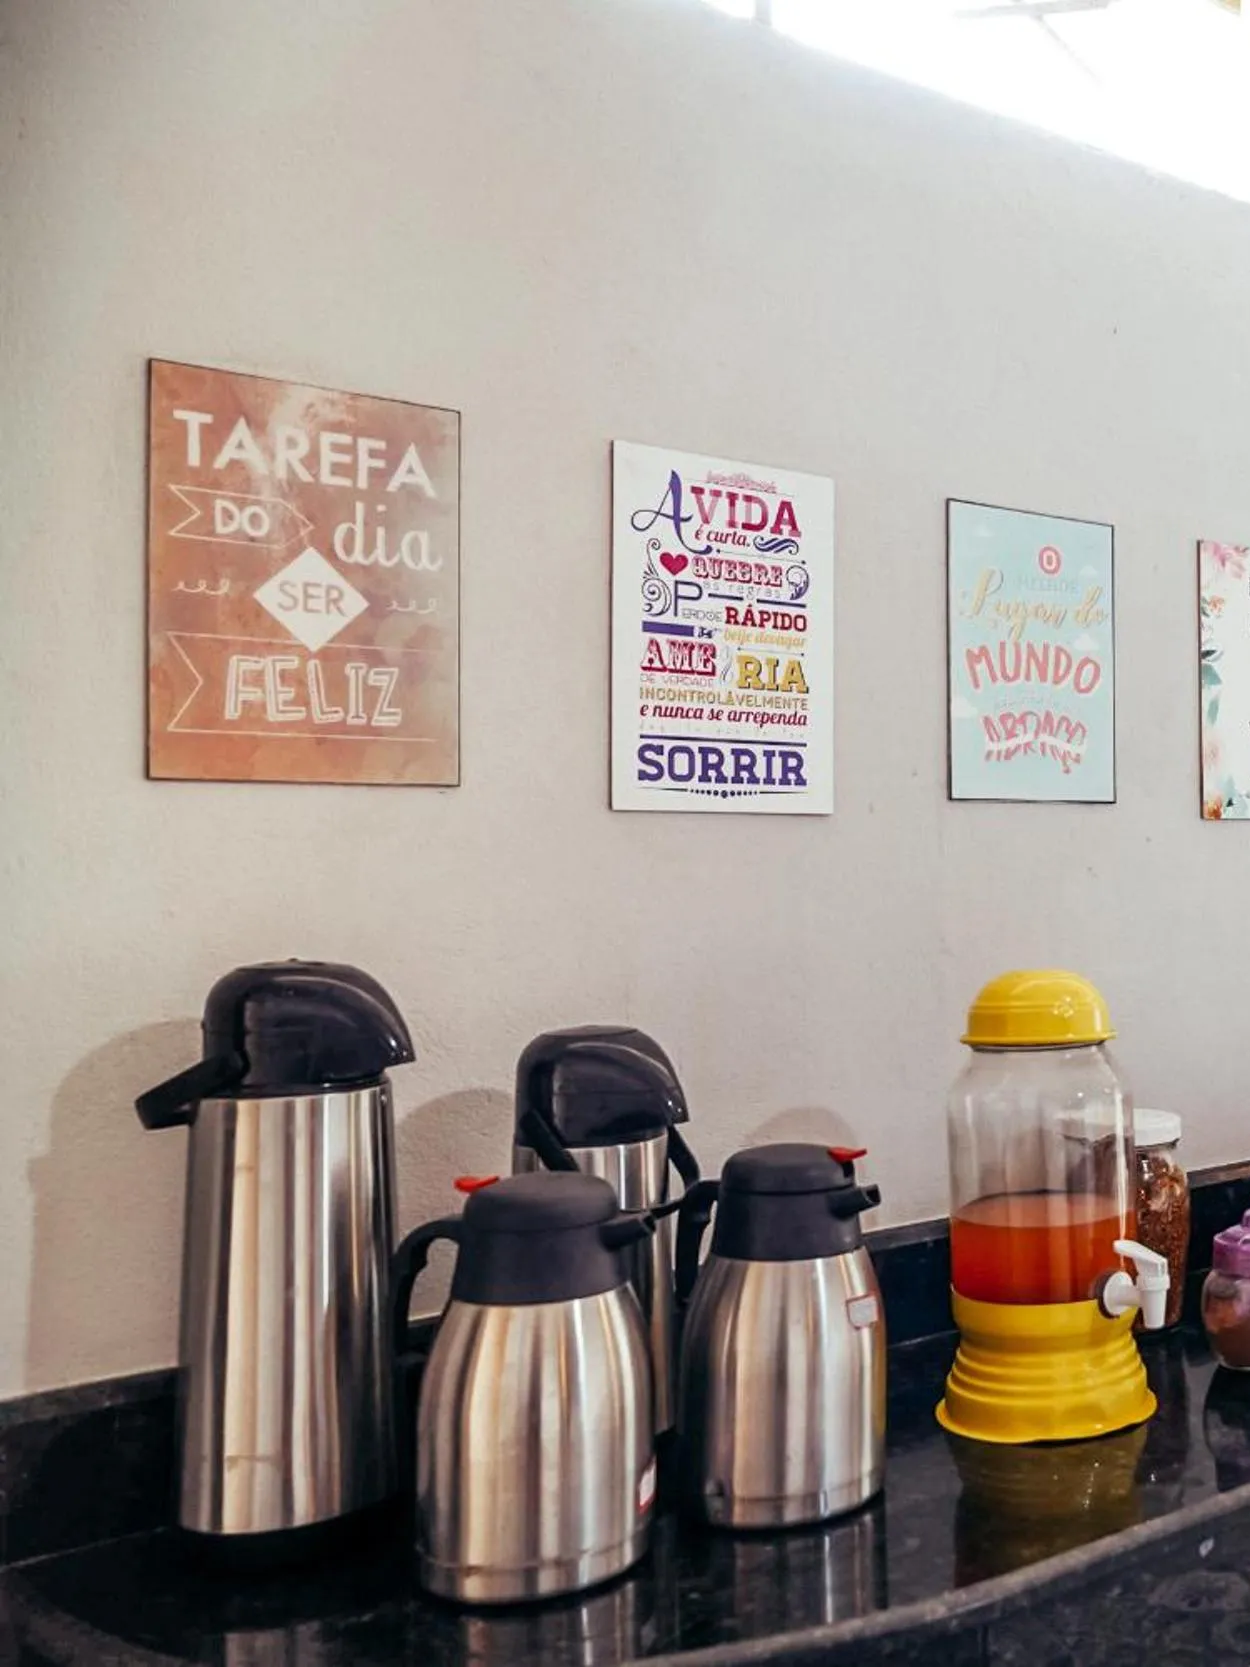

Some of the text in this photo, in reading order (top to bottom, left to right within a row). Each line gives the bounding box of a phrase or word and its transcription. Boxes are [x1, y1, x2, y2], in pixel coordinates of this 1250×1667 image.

[173, 410, 437, 498] TAREFA
[214, 499, 442, 571] DO dia
[631, 469, 802, 555] A VIDA
[706, 529, 751, 547] curta.
[692, 556, 783, 588] QUEBRE
[277, 581, 347, 617] SER
[725, 603, 807, 632] RÁPIDO
[640, 637, 717, 677] AME
[736, 654, 809, 693] RIA
[965, 640, 1101, 694] MUNDO
[225, 655, 401, 727] FELIZ
[640, 704, 808, 729] e nunca se arrependa
[637, 743, 808, 787] SORRIR
